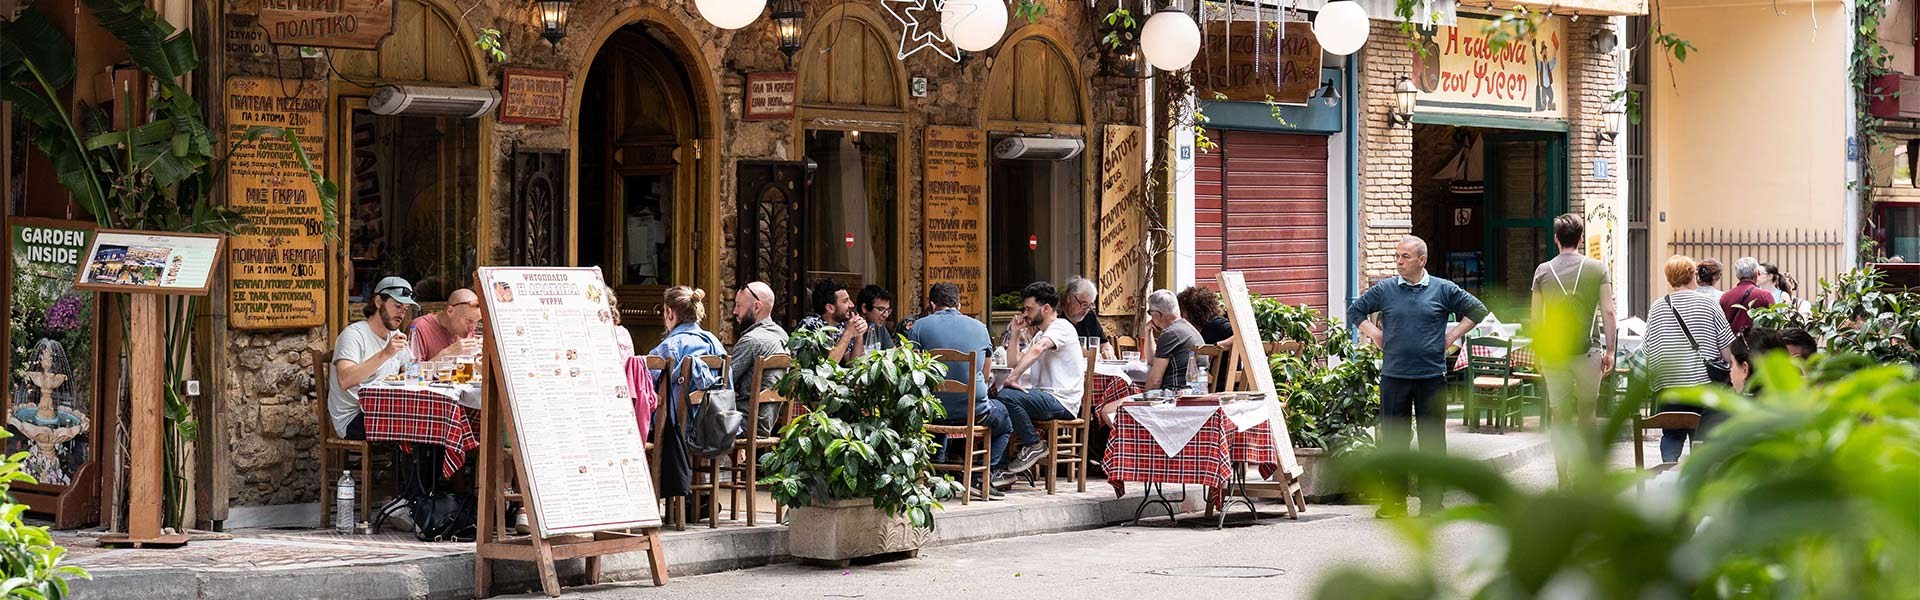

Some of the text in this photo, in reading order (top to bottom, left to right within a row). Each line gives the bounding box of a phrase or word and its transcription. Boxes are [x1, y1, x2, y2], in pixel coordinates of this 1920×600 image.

[226, 31, 262, 40] ΙΣΧΥΛΟΥ
[276, 14, 358, 40] ΠΟΛΙΤΙΚΟ
[1441, 70, 1469, 92] του
[255, 113, 259, 121] 2
[261, 113, 285, 122] ΑΤΟΜΑ
[1104, 130, 1138, 173] ΦΑΤΟΥΣ
[1182, 147, 1189, 158] 12
[1597, 161, 1606, 177] 12
[1103, 169, 1122, 192] FTUS
[246, 187, 306, 204] ΜΙΞ ΓΚΡΙΛ
[21, 227, 84, 247] GARDEN
[27, 245, 77, 264] INSIDE
[243, 265, 254, 274] ΓΙΑ
[258, 265, 262, 274] 2
[264, 265, 287, 274] ΑΤΟΜΑ
[1100, 245, 1138, 294] ΧΟΥΜΟΥΣ
[539, 297, 563, 305] ΨΥΡΡΗ
